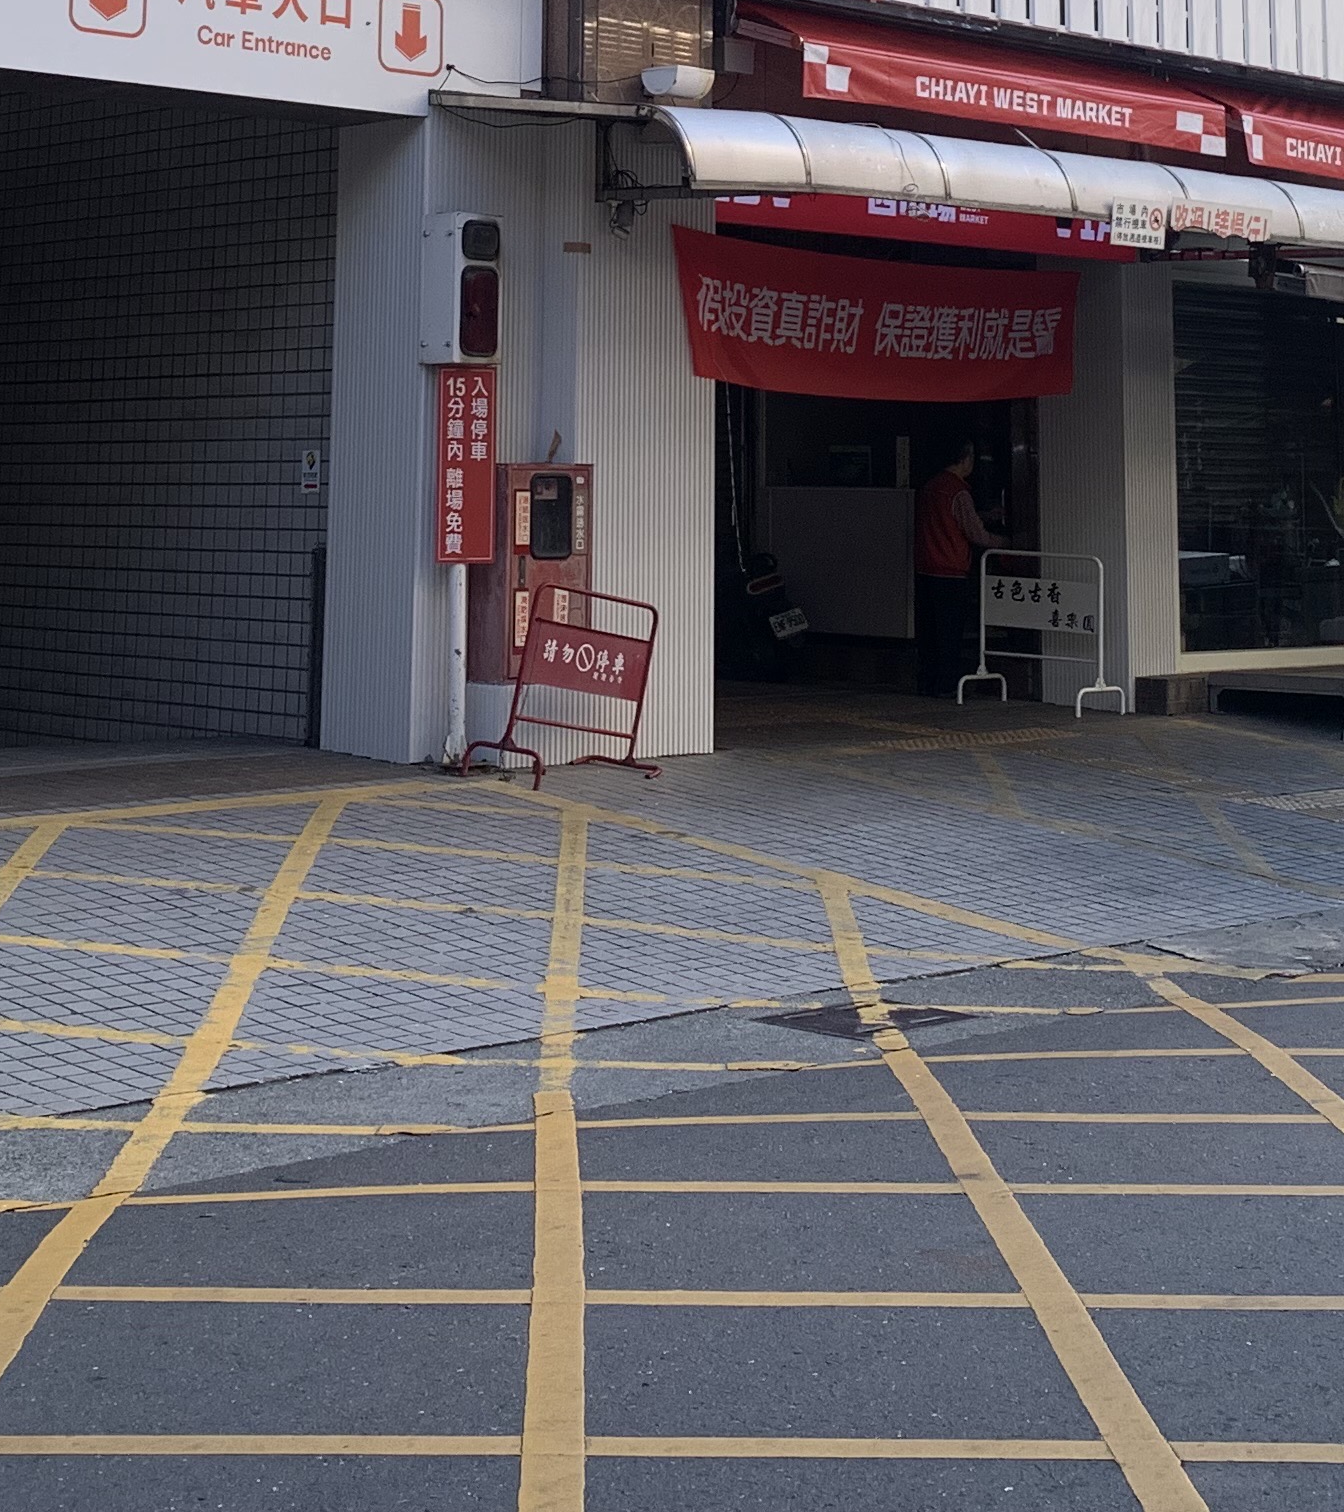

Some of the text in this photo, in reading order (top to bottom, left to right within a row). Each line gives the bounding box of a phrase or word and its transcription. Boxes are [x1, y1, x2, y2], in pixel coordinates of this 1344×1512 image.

[197, 25, 332, 61] Car Entrance
[916, 76, 1133, 128] CHIAYI WEST MARKET
[1286, 137, 1342, 166] CHIAYI
[696, 275, 864, 354] 假投資真詐財
[470, 376, 489, 462] 入場停車
[444, 376, 466, 555] 15分鐘內 離場免費
[992, 579, 1061, 604] 古色古香
[543, 639, 625, 675] 請勿 停車
